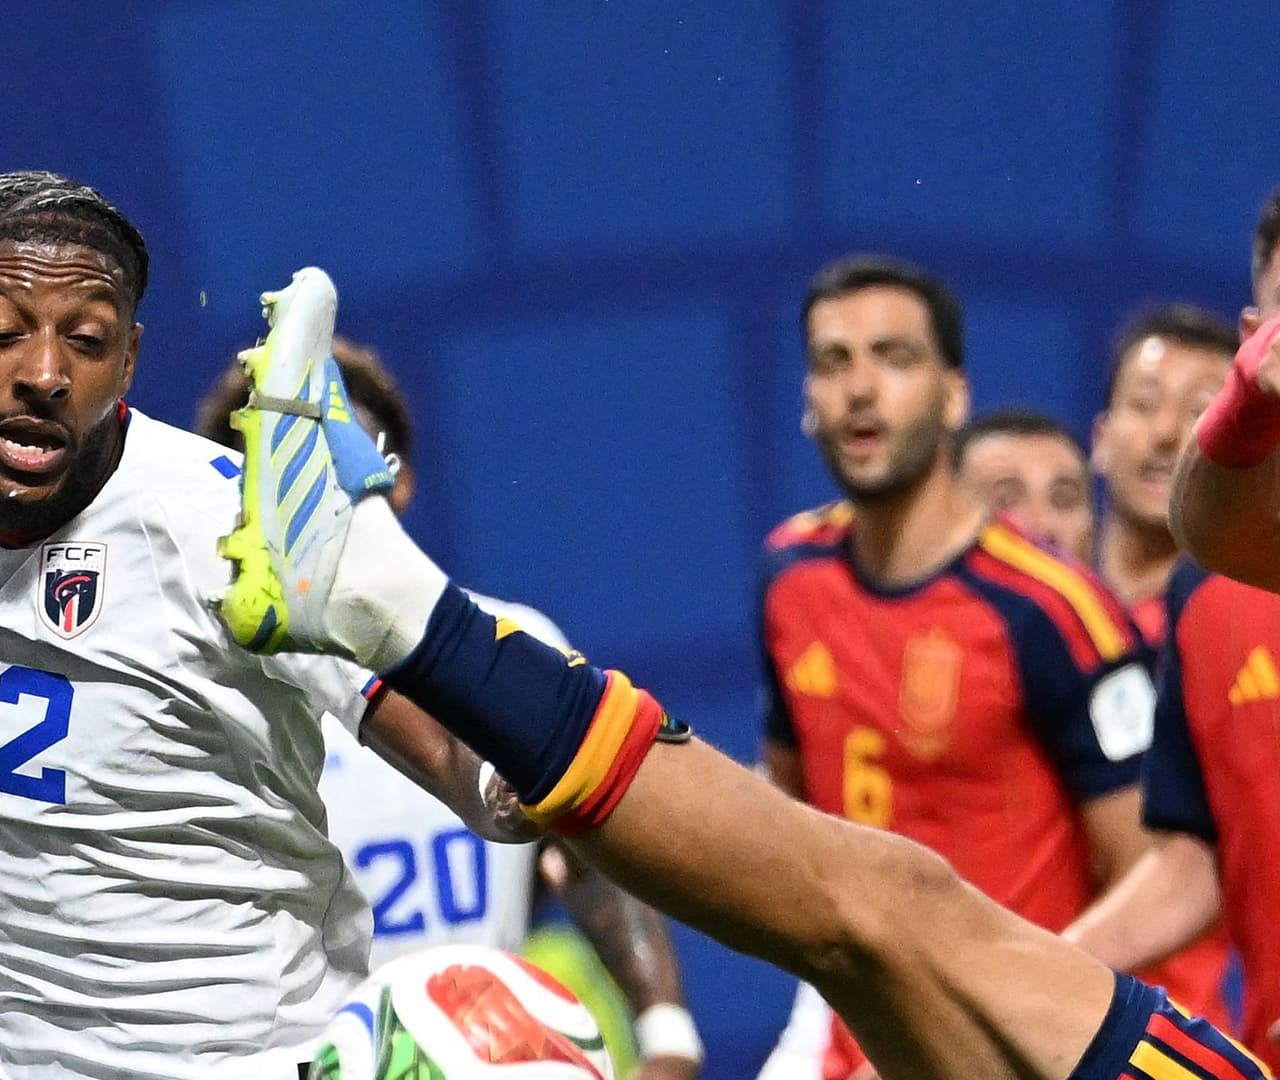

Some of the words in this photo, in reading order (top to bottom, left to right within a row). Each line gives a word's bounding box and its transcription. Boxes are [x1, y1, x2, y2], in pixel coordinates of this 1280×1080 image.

[47, 547, 101, 562] FCF
[842, 725, 894, 829] 6
[356, 829, 488, 934] 20
